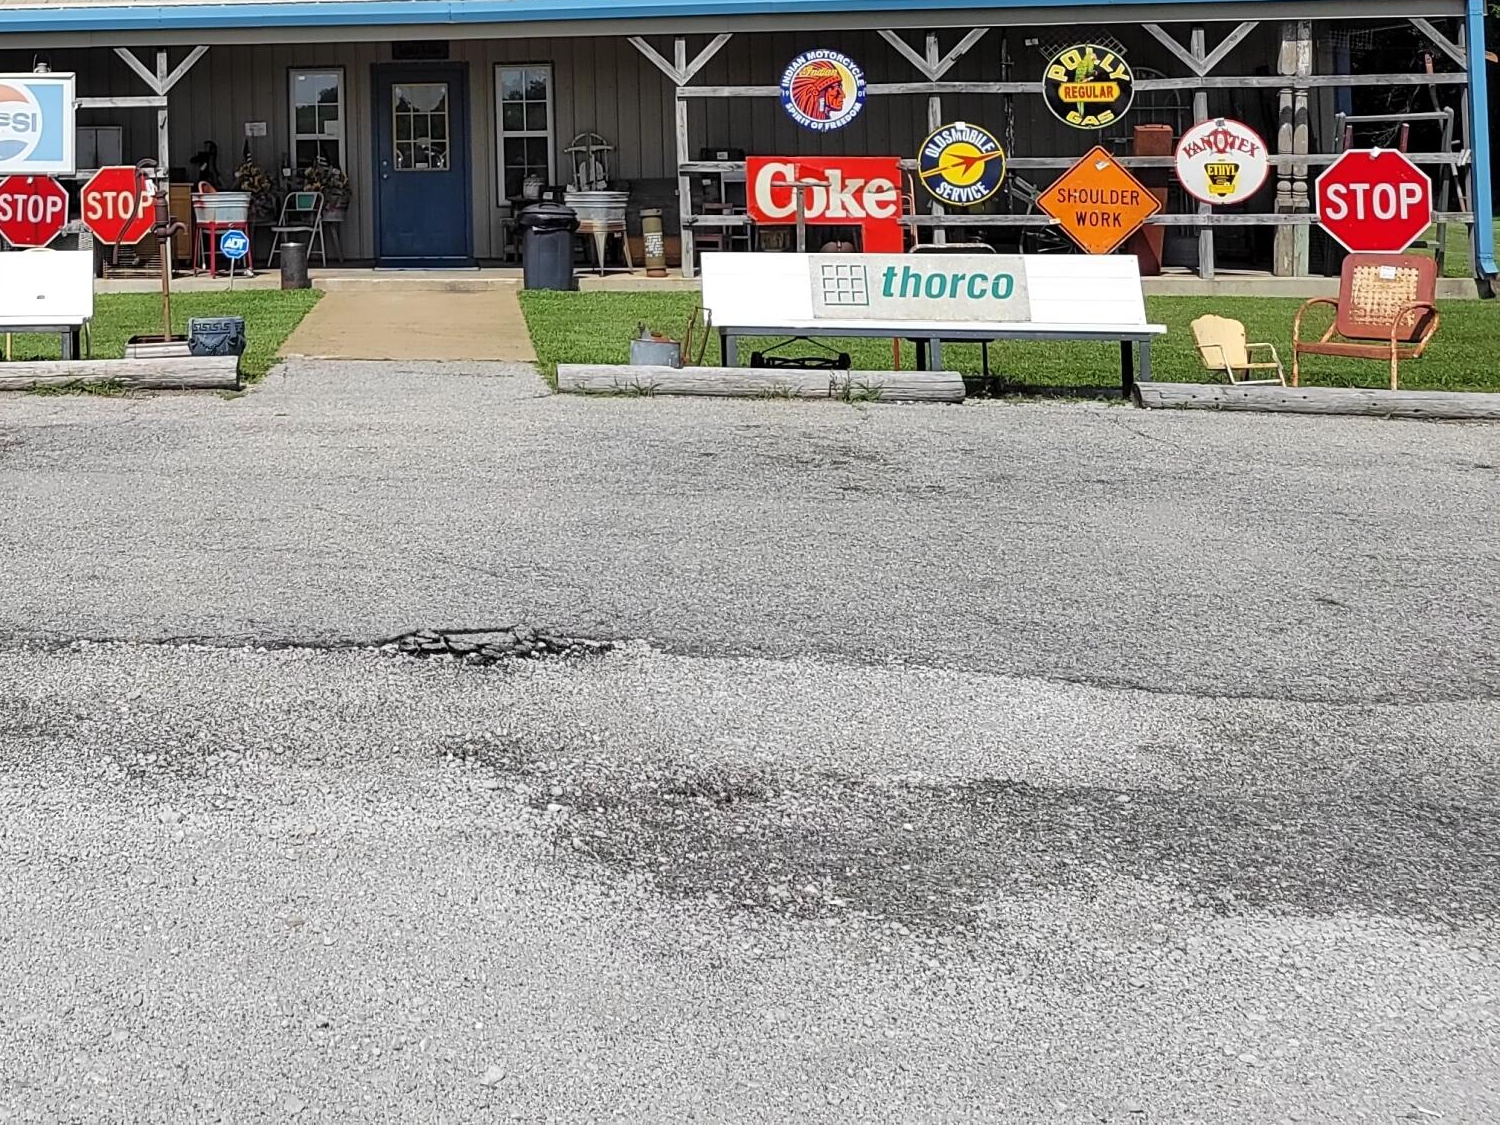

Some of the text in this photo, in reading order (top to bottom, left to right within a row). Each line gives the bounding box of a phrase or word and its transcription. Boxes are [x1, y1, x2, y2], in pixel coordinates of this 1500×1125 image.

[781, 50, 866, 87] INDIAN MOTORCYCLE
[1047, 47, 1130, 82] POLY
[1064, 85, 1114, 99] REGULAR
[785, 102, 862, 130] SPIRIT OF FREEDOM
[1065, 109, 1115, 126] GAS
[925, 127, 996, 158] OLDSMOBILE
[1206, 164, 1237, 176] ETHYL
[754, 162, 898, 219] Coke
[936, 181, 990, 202] SERVICE
[1056, 187, 1140, 206] SHOULDER
[1325, 182, 1423, 220] STOP
[86, 190, 154, 221] STOP
[1075, 211, 1122, 228] WORK
[224, 237, 246, 250] ADT
[882, 265, 1014, 300] thorco
